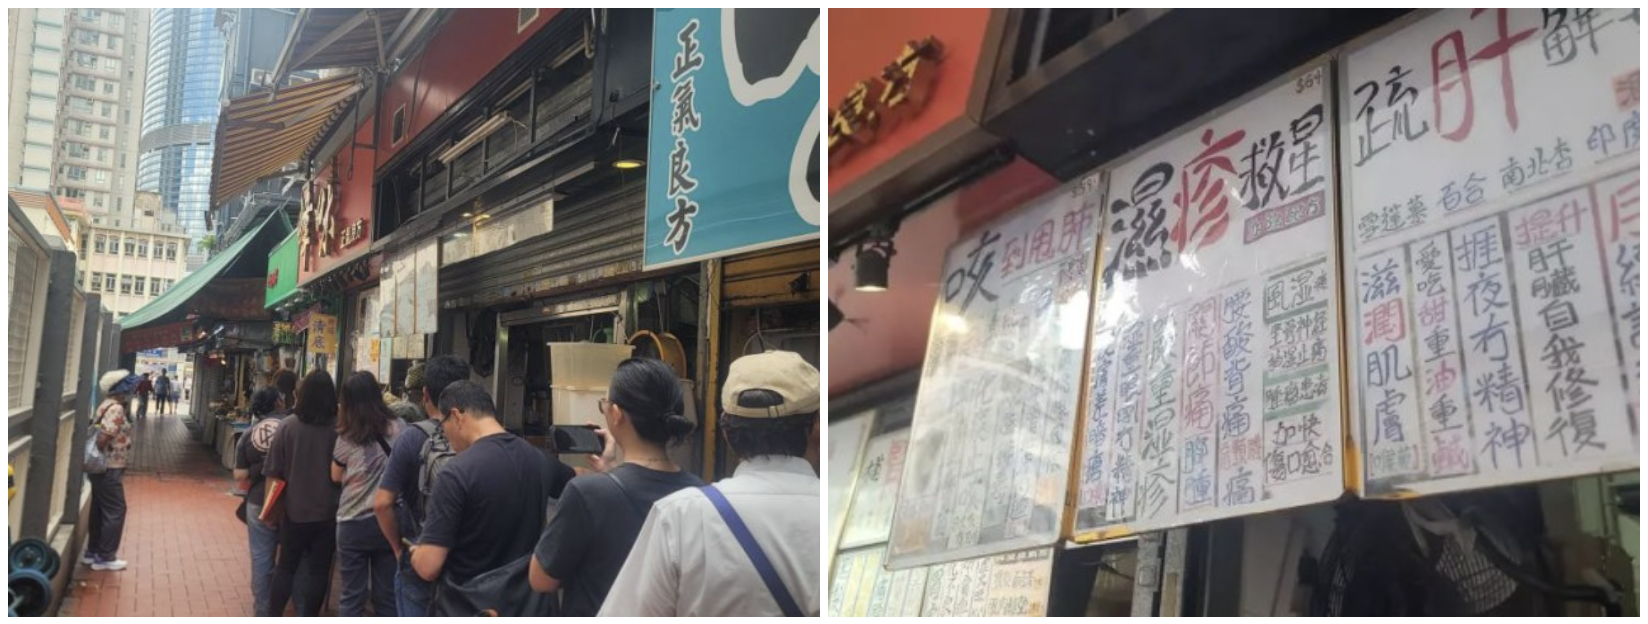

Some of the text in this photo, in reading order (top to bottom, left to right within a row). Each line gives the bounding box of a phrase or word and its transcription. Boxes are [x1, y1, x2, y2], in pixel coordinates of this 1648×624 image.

[663, 19, 704, 255] 正氣良方
[1103, 103, 1325, 291] 濕疹救星
[1500, 137, 1573, 190] 南北杏
[1272, 413, 1322, 447] 加快
[1360, 257, 1413, 447] 滋潤肌膚
[1455, 222, 1532, 470] 捱夜冇精神
